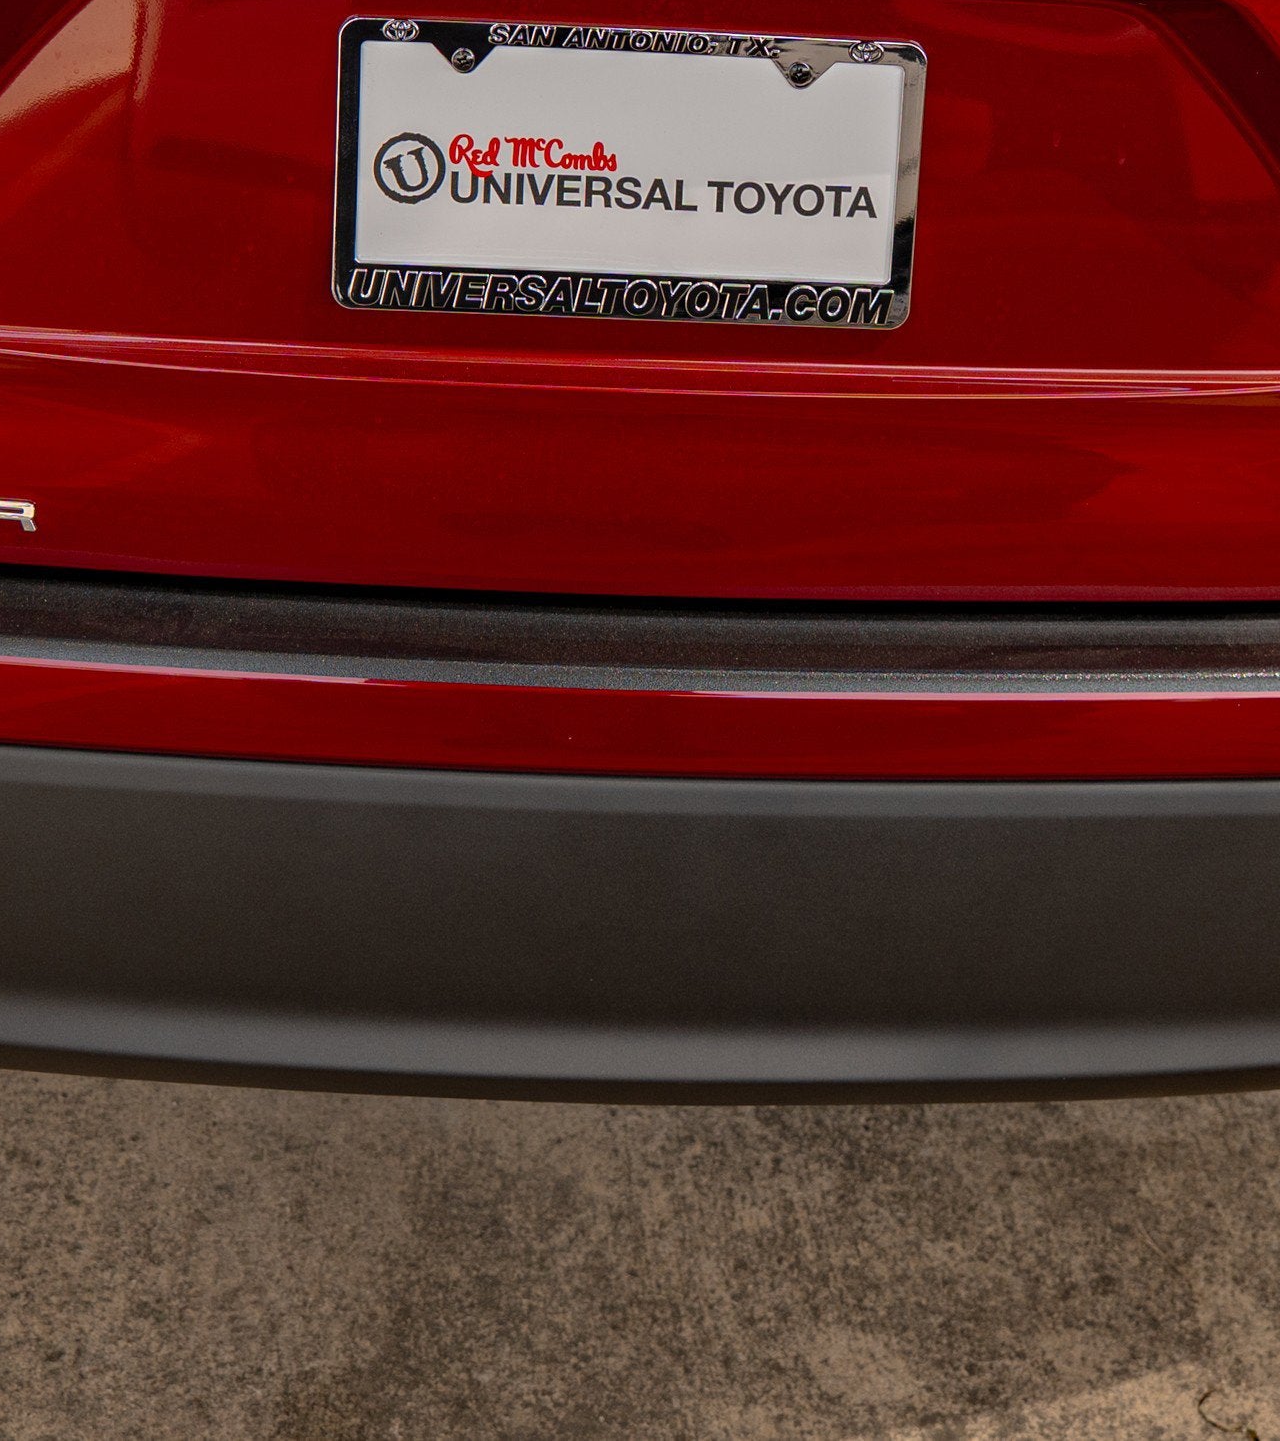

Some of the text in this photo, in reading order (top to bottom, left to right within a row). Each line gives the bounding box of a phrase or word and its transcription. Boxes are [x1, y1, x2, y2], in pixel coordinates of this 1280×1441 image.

[488, 23, 557, 46] SAN
[562, 27, 719, 54] ANTONIO,
[449, 133, 617, 178] Red McCombs
[450, 170, 878, 219] UNIVERSAL TOYOTA
[348, 268, 894, 325] UNIVERSALTOYOTA.COM
